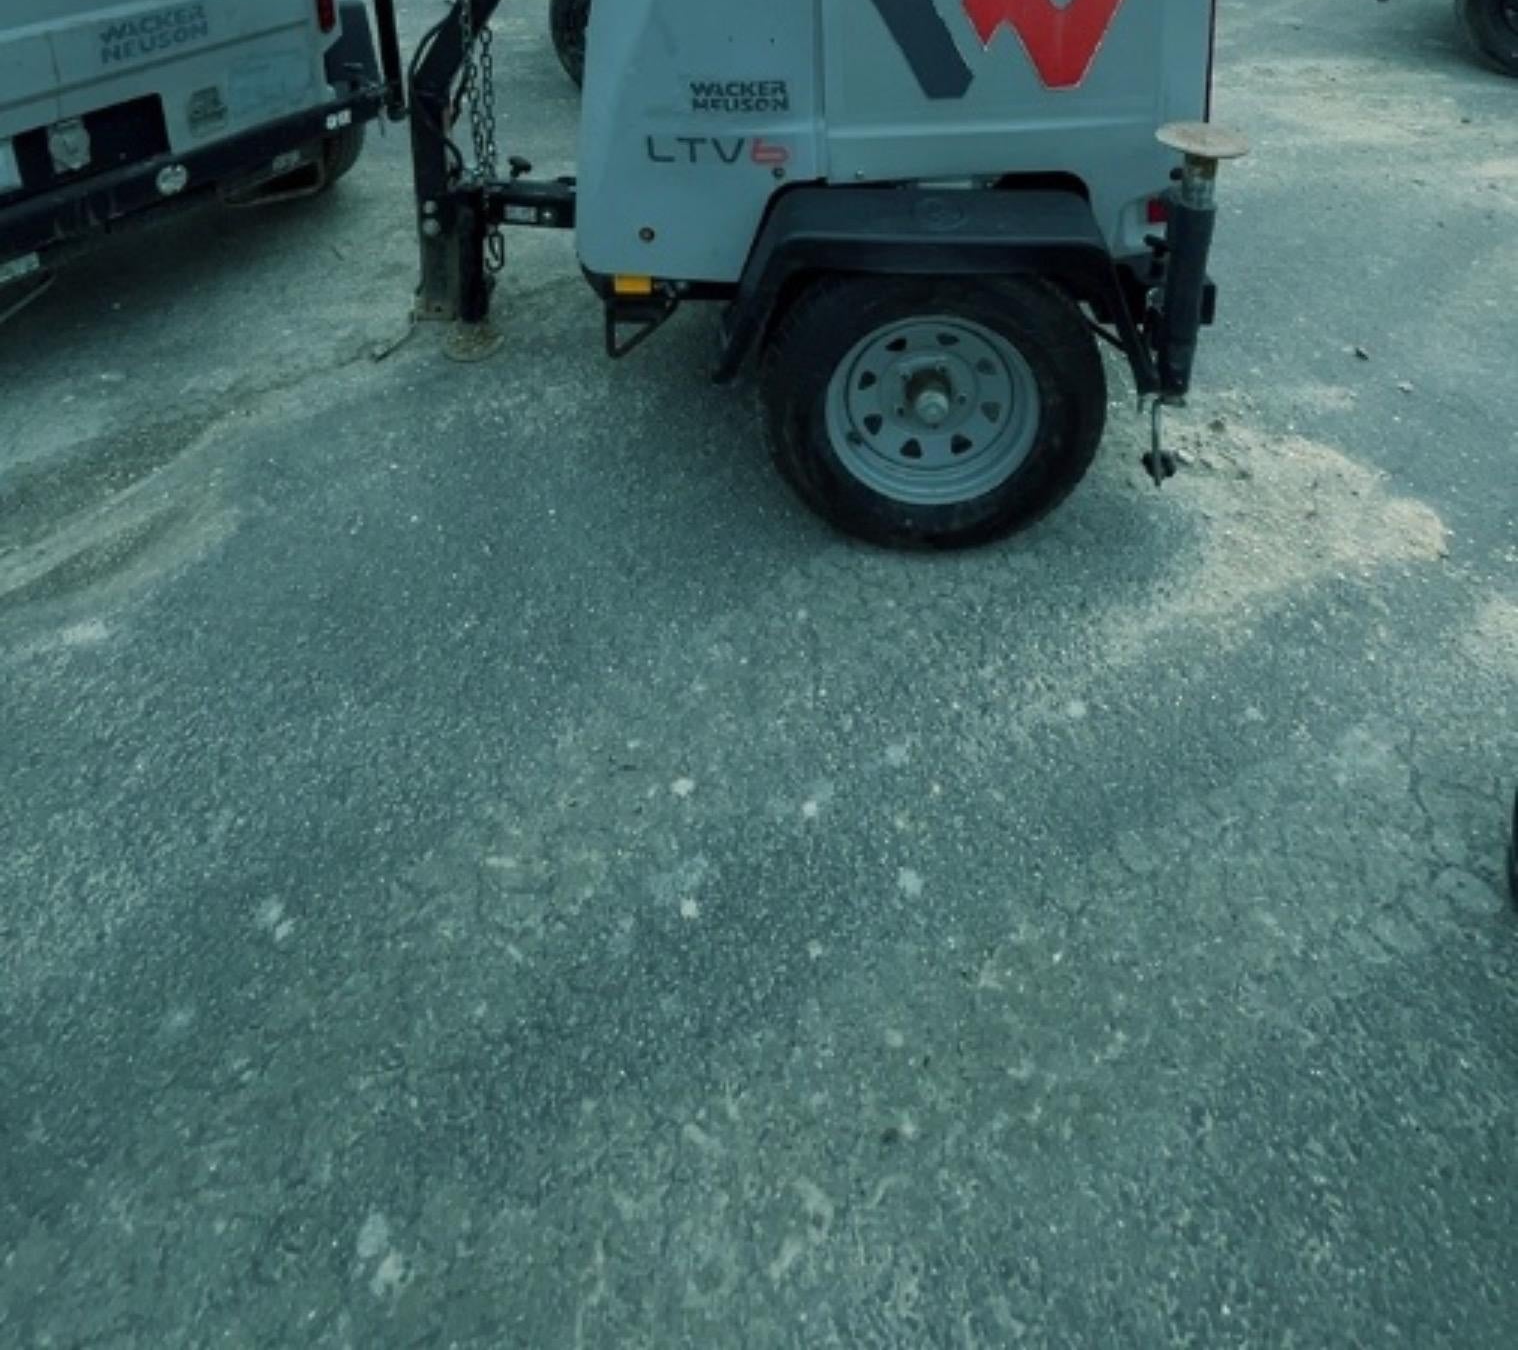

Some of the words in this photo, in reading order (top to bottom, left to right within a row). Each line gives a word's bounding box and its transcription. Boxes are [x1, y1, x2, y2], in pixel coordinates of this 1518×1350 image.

[689, 80, 787, 98] WACKER
[691, 96, 790, 112] NEUSON
[646, 135, 790, 164] LTV6
